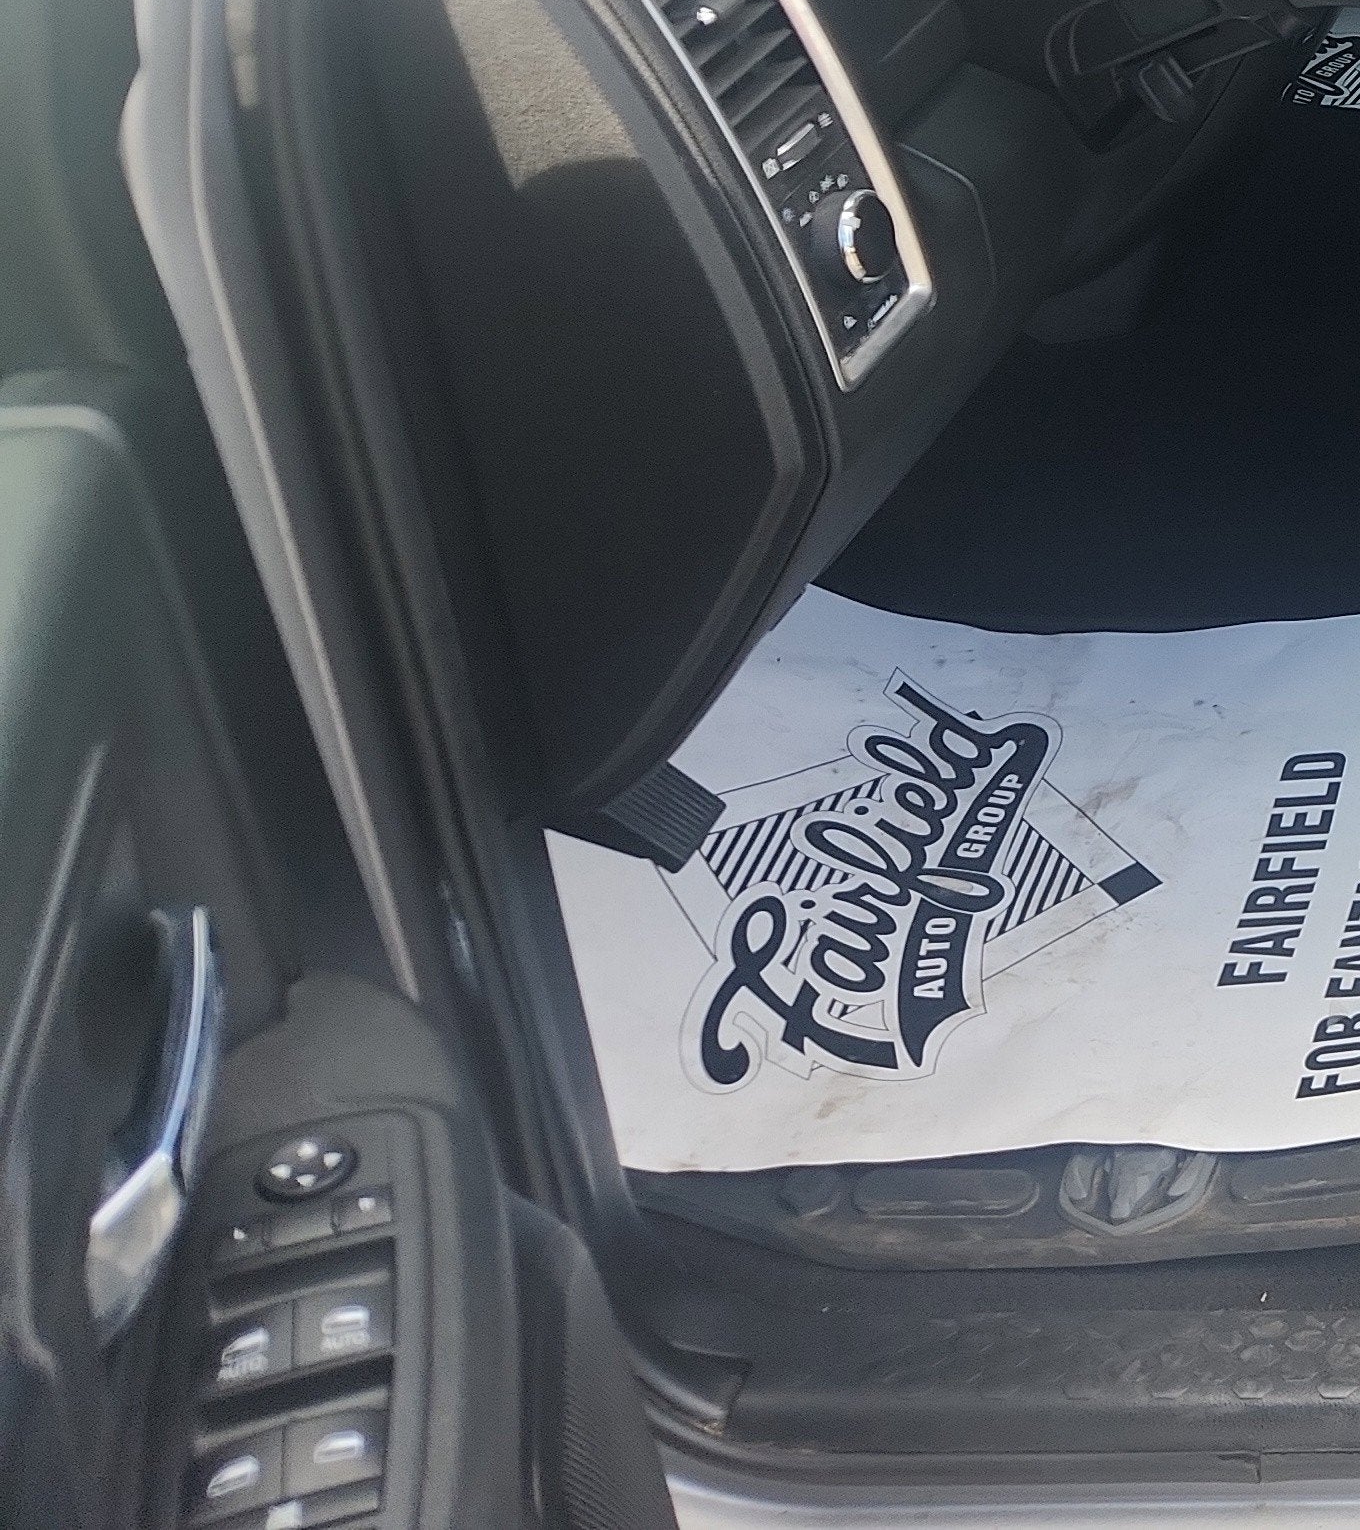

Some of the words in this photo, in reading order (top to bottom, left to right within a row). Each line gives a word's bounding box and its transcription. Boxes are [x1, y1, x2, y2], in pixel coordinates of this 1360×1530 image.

[1315, 53, 1356, 78] GROUP
[701, 681, 1049, 1085] Fairfield
[913, 917, 958, 998] AUTO
[956, 773, 1024, 859] GROUP
[1217, 751, 1347, 987] FAIRFIELD
[320, 1331, 371, 1352] AUTO
